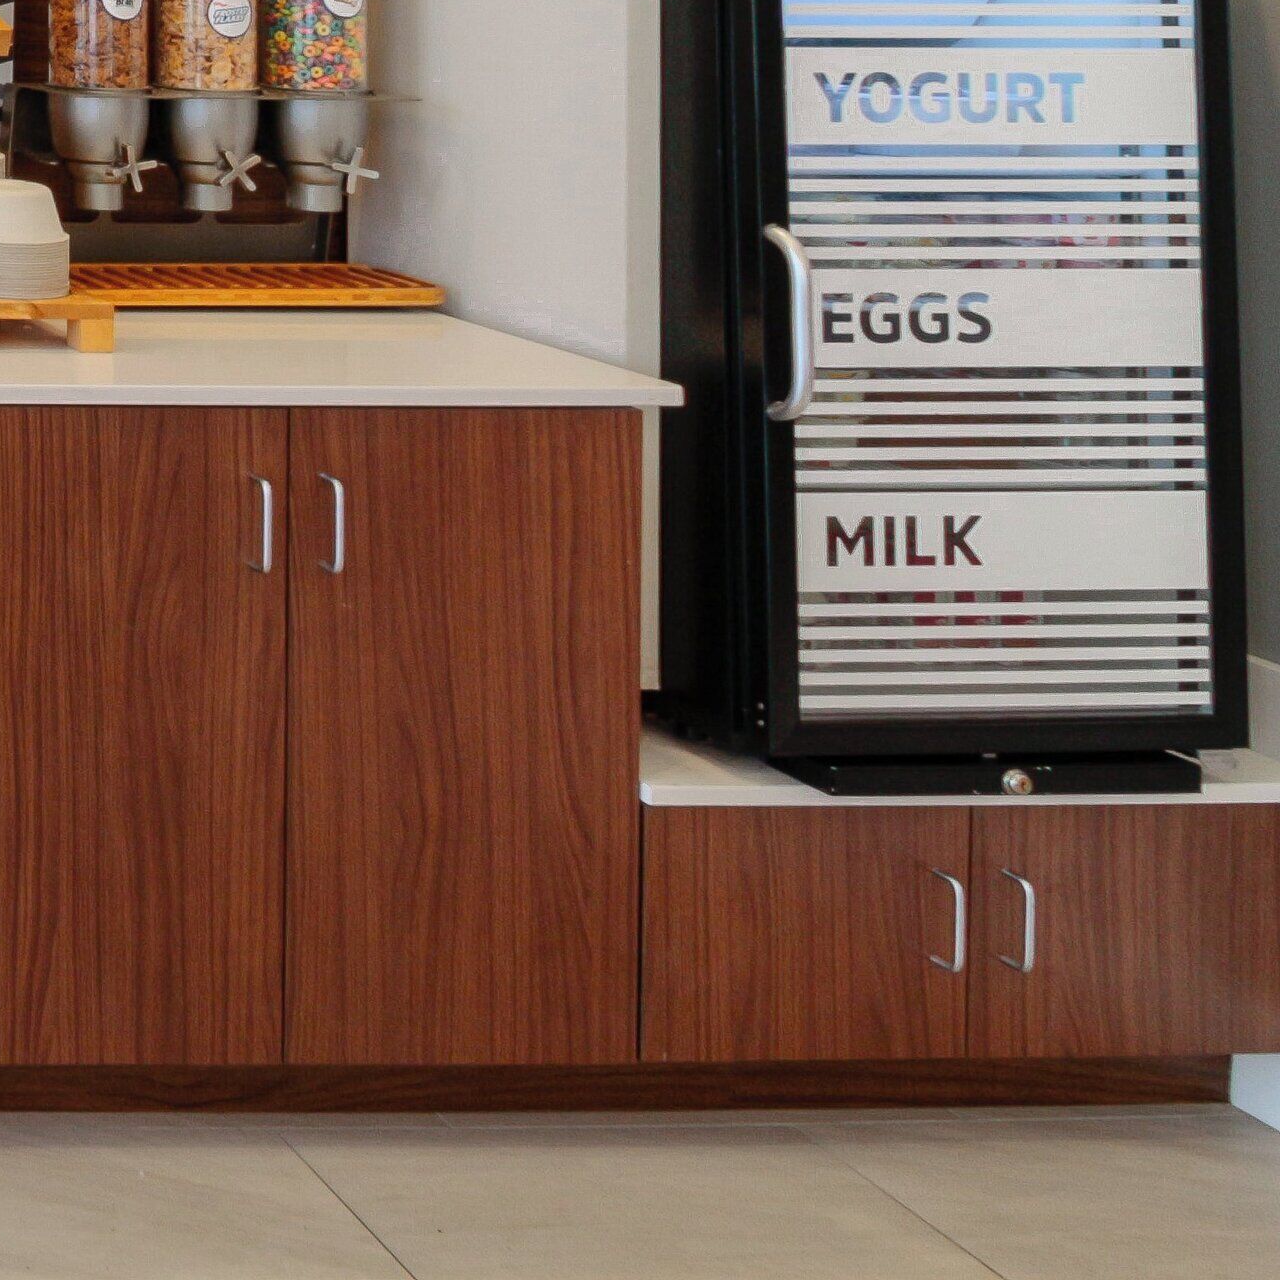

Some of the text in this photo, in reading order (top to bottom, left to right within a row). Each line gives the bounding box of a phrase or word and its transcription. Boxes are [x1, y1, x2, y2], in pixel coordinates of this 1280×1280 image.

[812, 71, 1085, 125] YOGURT
[821, 291, 993, 344] EGGS
[826, 514, 983, 567] MILK
